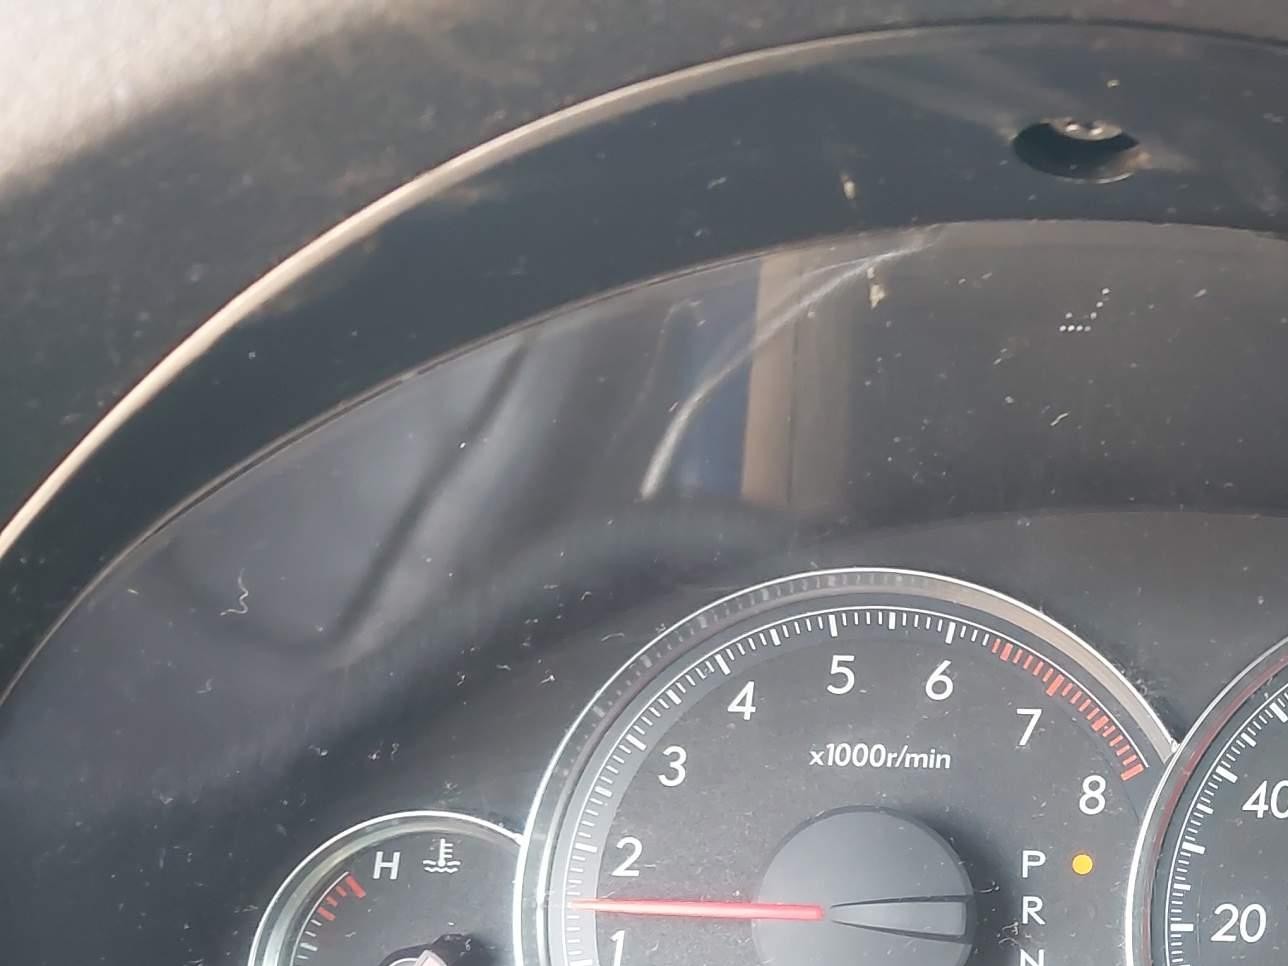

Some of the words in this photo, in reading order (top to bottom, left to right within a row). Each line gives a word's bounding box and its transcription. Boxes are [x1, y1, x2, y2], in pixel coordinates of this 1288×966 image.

[827, 655, 856, 695] 5
[925, 660, 954, 700] 6
[728, 681, 757, 721] 4
[1016, 708, 1042, 746] 7
[658, 746, 687, 787] 3
[1079, 775, 1106, 815] 8
[372, 851, 401, 880] H
[612, 837, 641, 877] 2
[1022, 850, 1047, 878] P
[1022, 895, 1046, 926] R
[1211, 903, 1267, 943] 20
